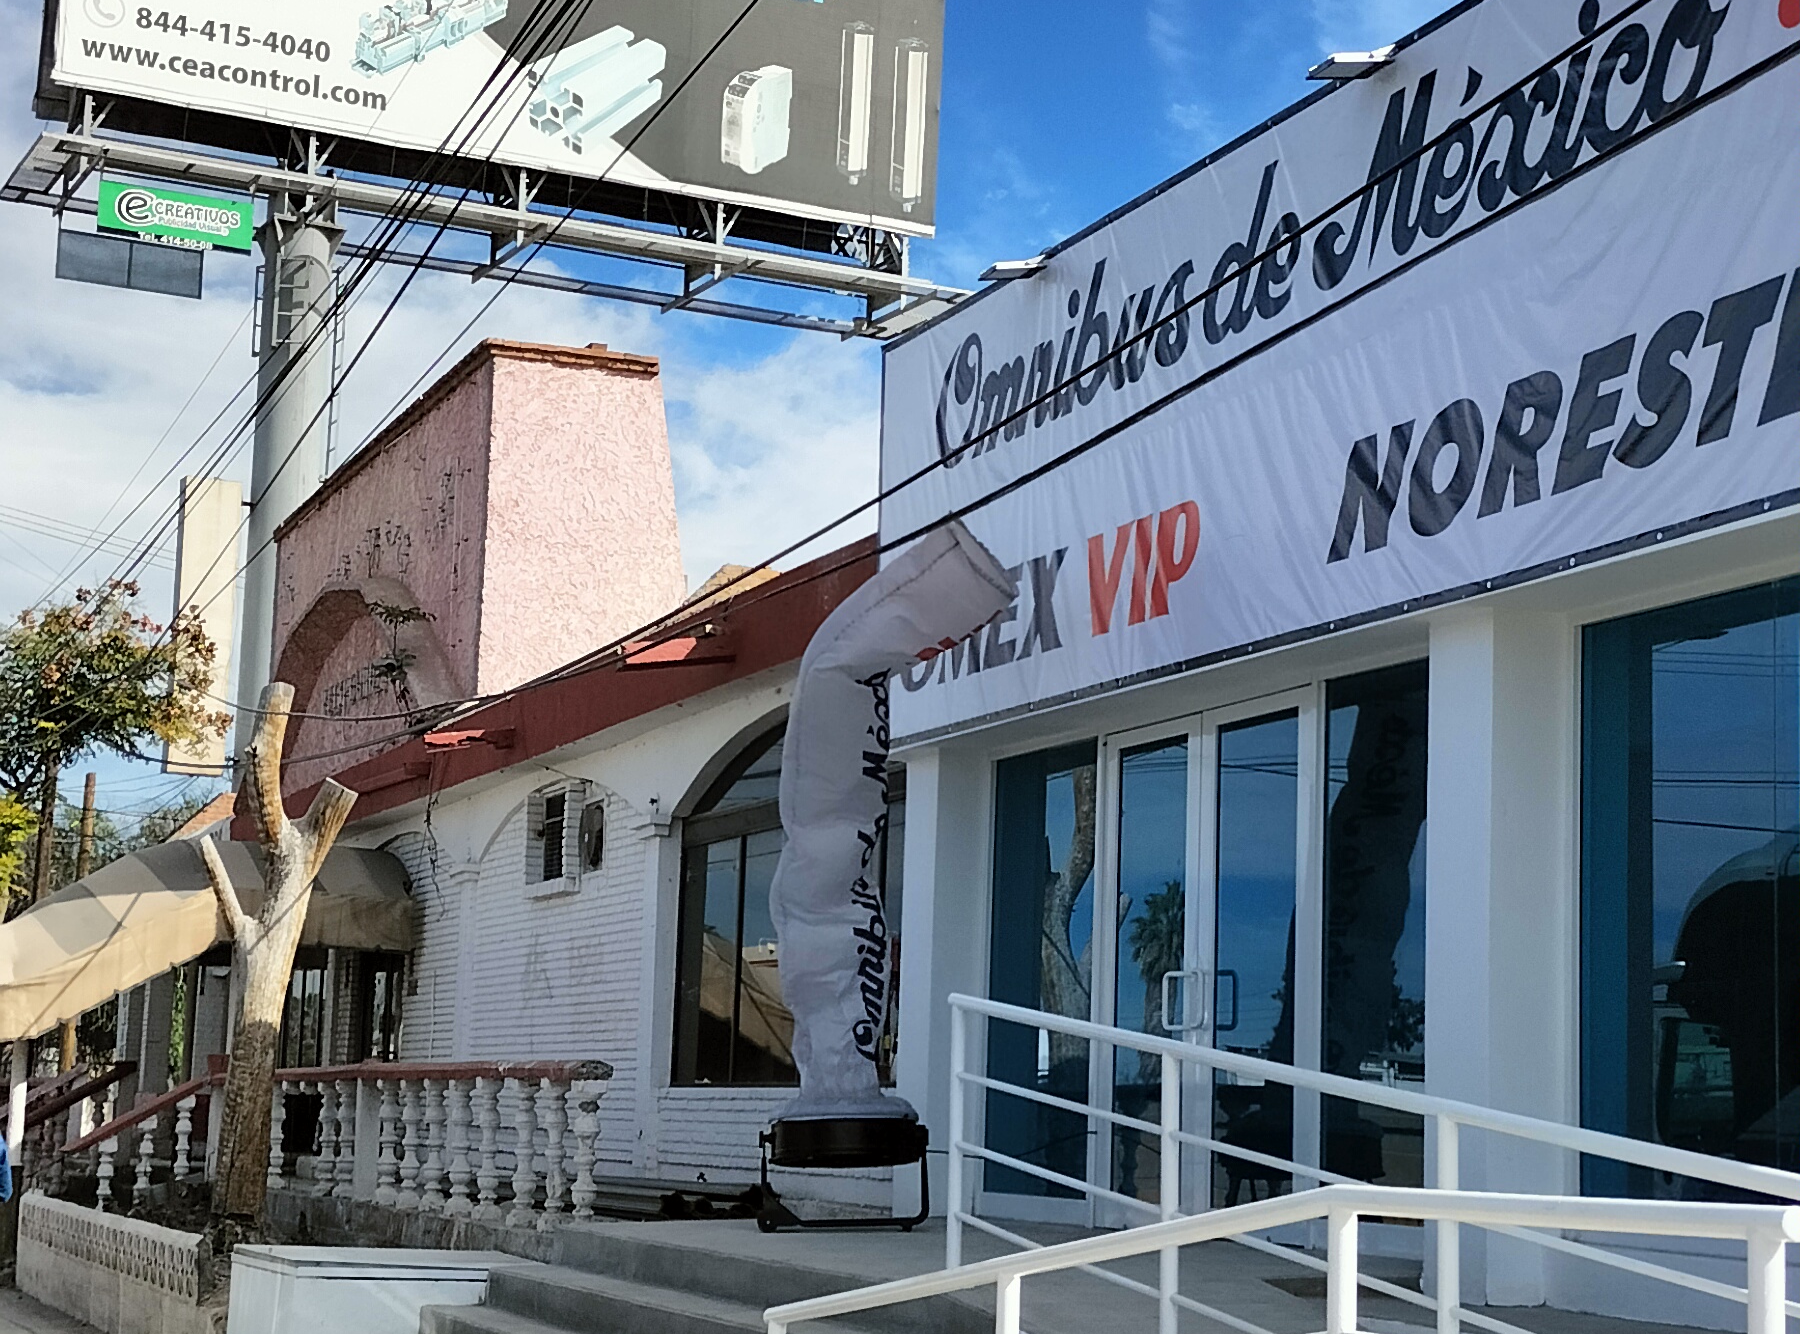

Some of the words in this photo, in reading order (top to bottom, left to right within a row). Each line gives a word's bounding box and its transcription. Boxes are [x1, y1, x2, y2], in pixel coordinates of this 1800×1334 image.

[135, 7, 331, 62] 844-415-4040
[81, 38, 387, 111] www.ceacontrol.com
[138, 231, 159, 243] Tel.
[158, 216, 197, 229] Publicidad
[199, 221, 222, 233] Visual
[935, 257, 1195, 468] Omnibus
[1202, 160, 1301, 345] de
[1087, 499, 1201, 638] VIP
